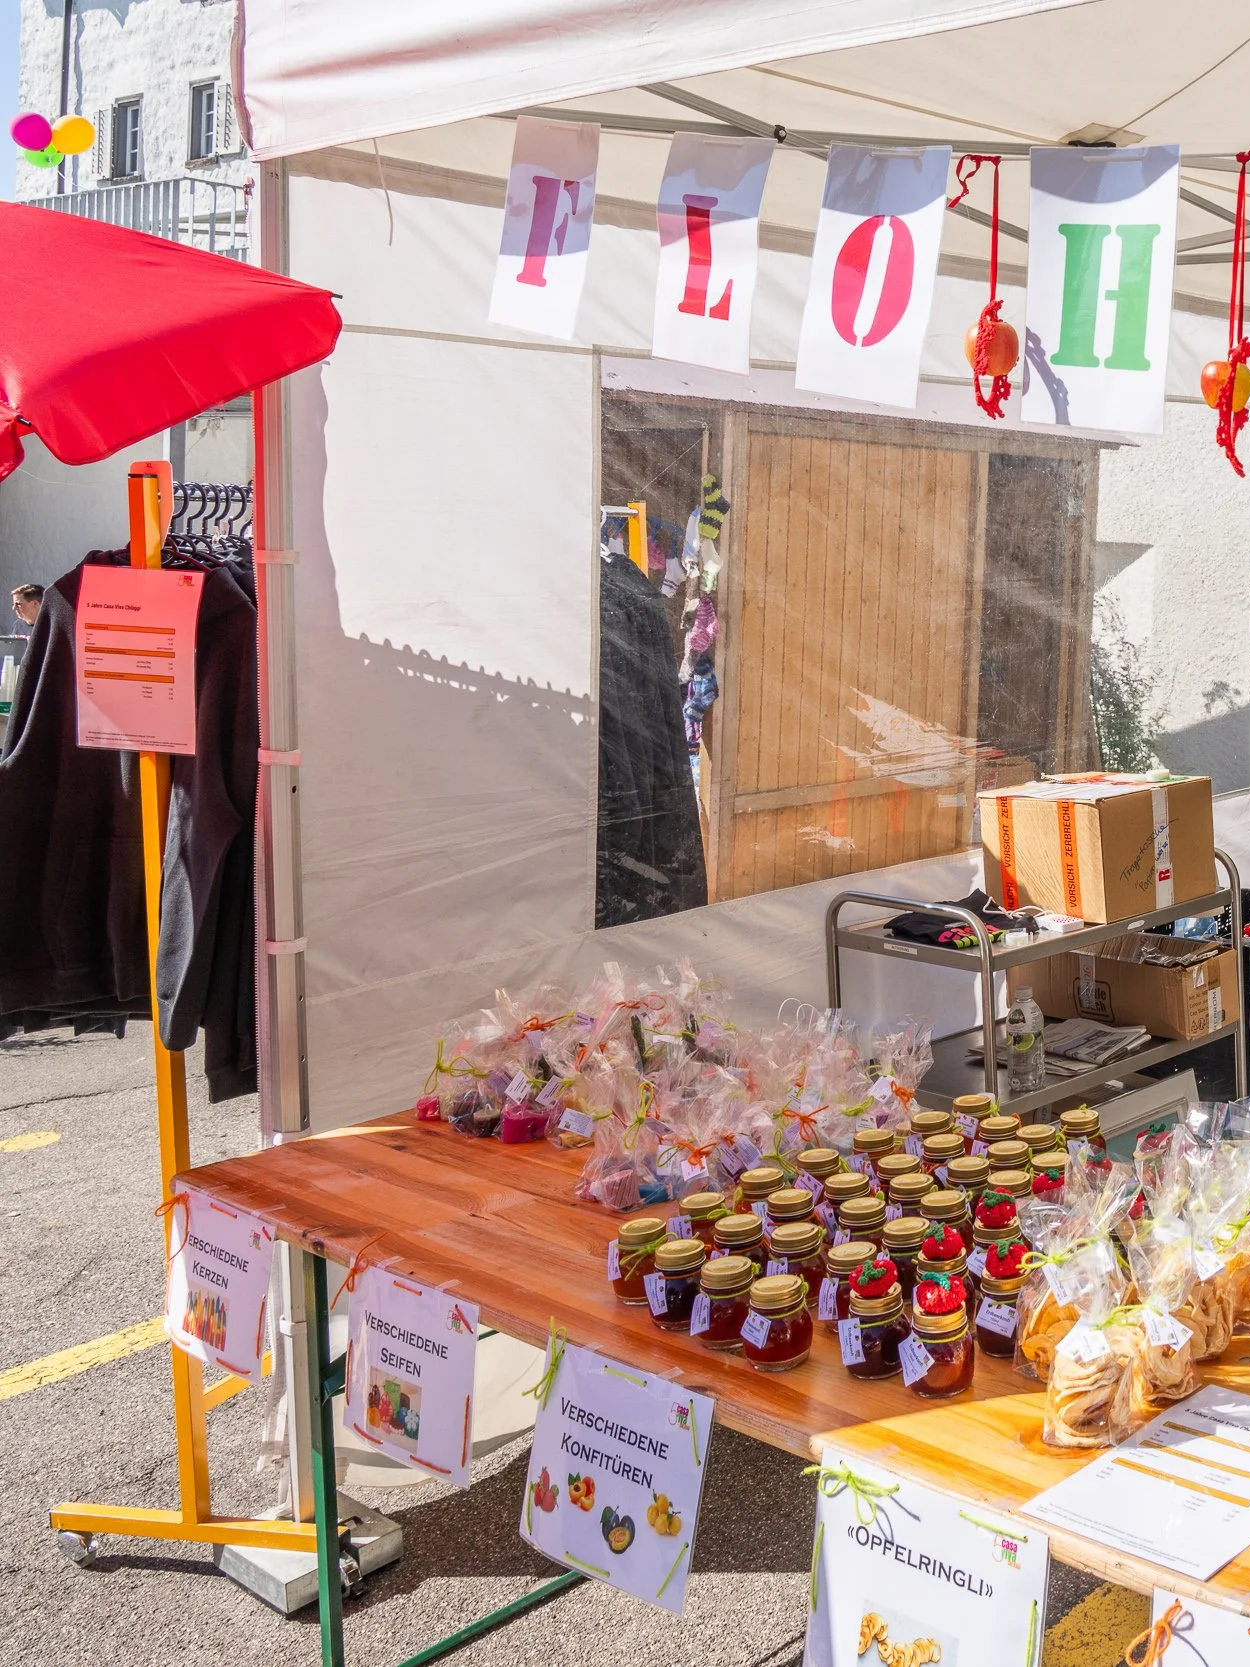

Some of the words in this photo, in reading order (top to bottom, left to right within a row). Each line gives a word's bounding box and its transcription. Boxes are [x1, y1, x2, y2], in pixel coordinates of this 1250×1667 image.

[1002, 824, 1012, 868] VORSICHT
[1066, 863, 1077, 908] VORSICHT
[192, 1260, 229, 1290] KERZEN
[364, 1309, 448, 1360] VERSCHIEDENE
[380, 1347, 422, 1378] SEIFEN
[560, 1397, 669, 1460] VERSCHIEDENE
[560, 1432, 653, 1489] KONFITÜREN
[847, 1525, 994, 1598] «OPFELRINGLI»
[1001, 1539, 1018, 1553] casa
